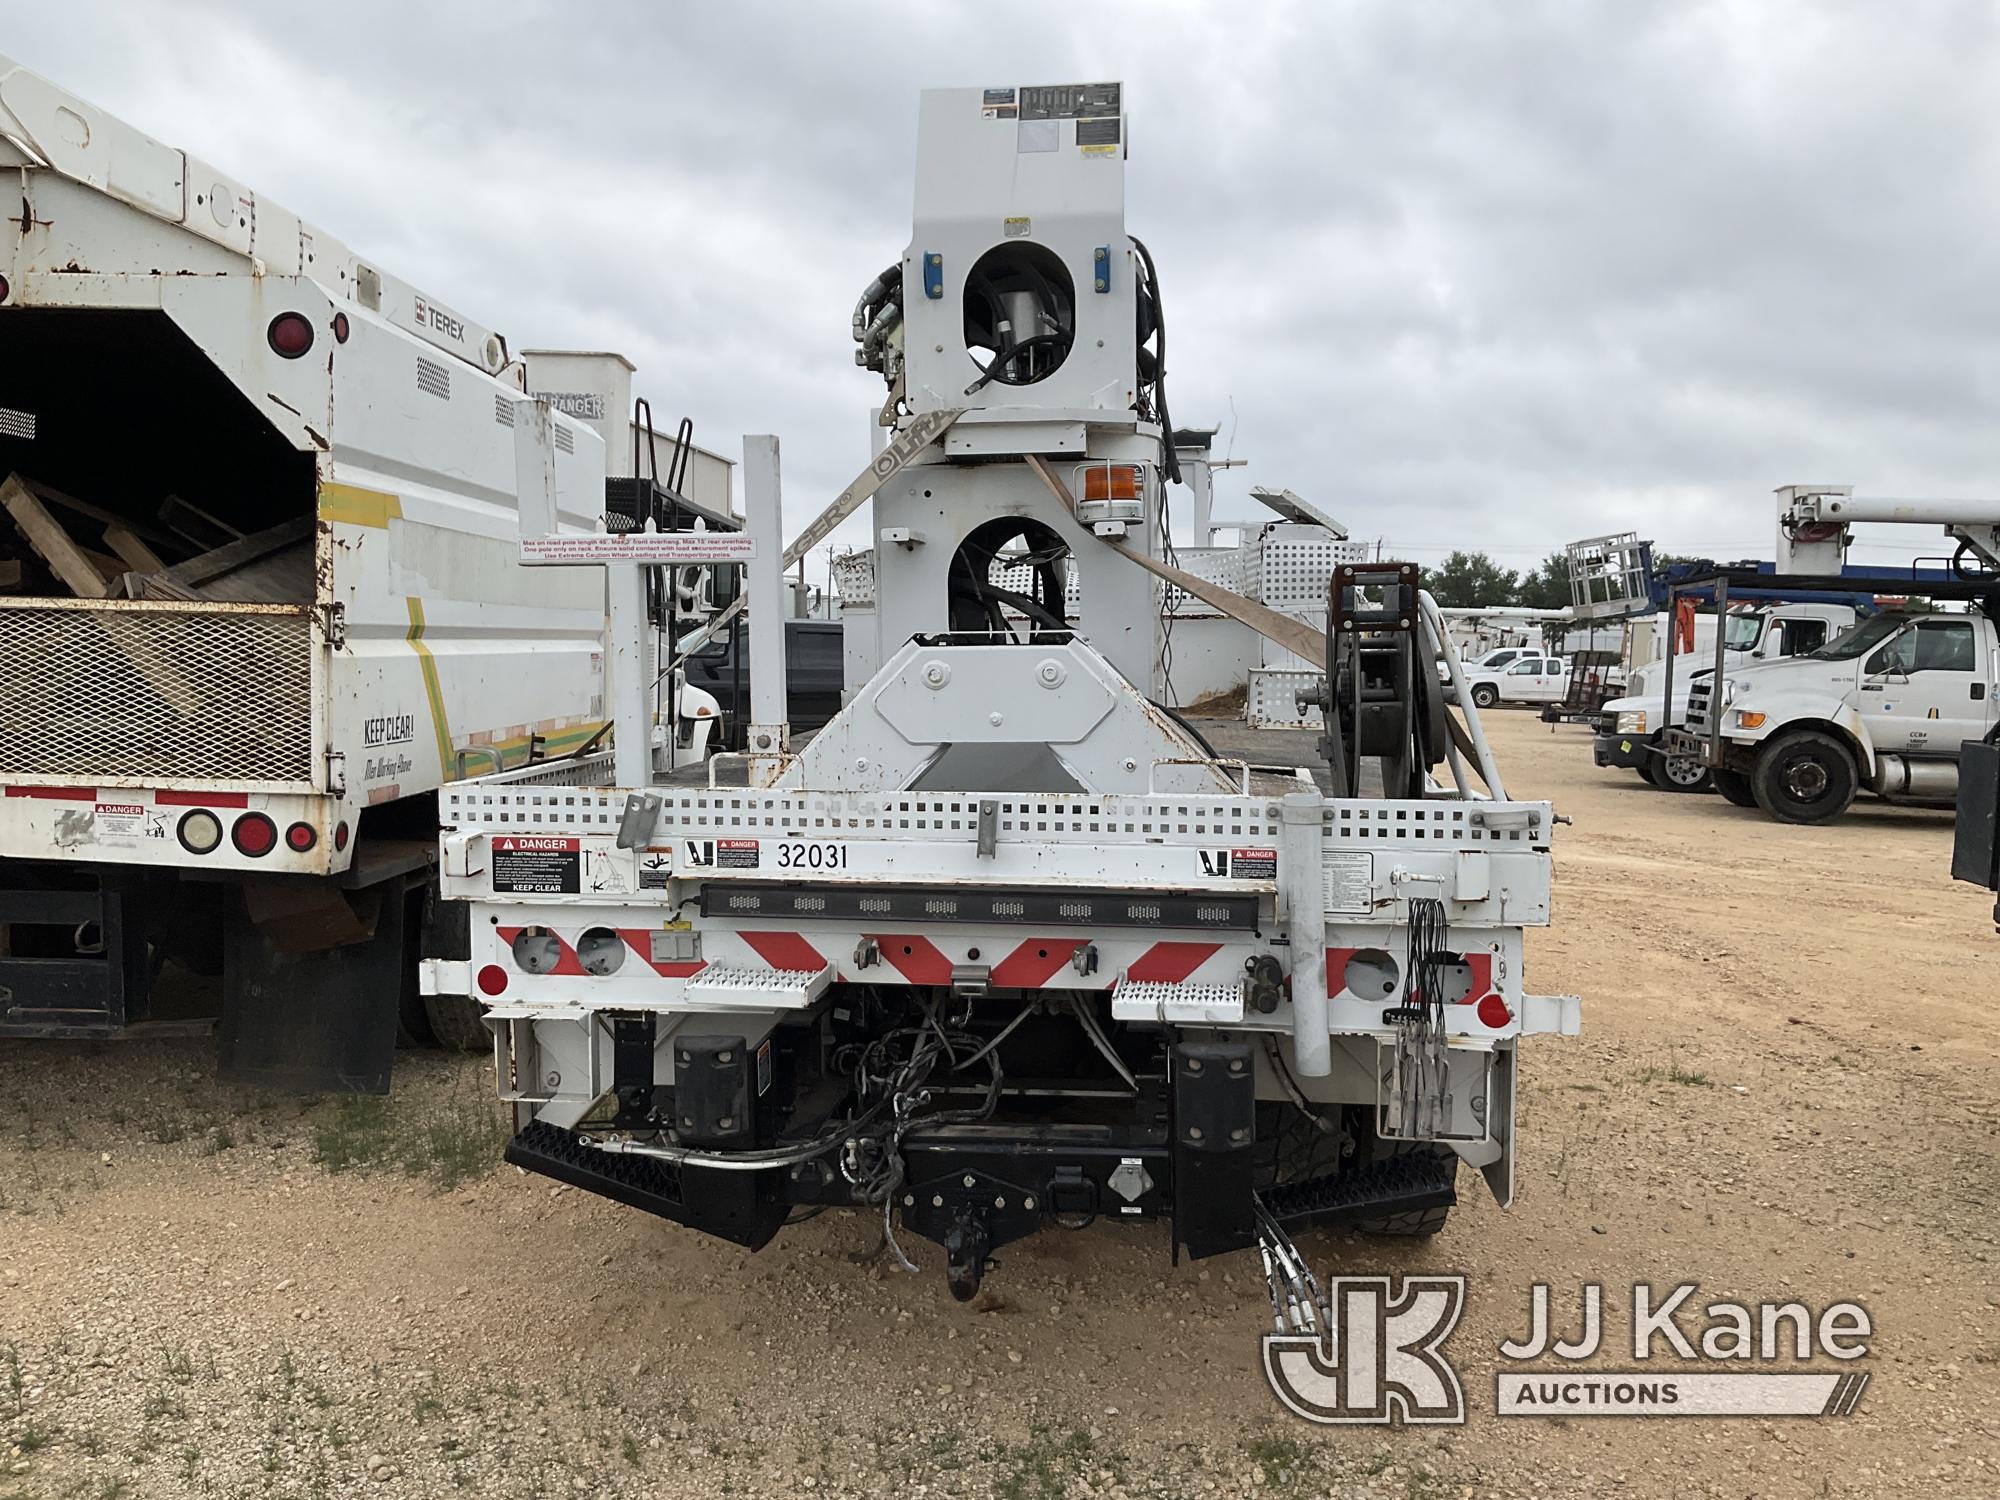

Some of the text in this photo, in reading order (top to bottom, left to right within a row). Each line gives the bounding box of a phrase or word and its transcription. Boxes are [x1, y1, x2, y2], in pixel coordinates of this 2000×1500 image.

[428, 306, 464, 343] TEREX
[364, 714, 414, 745] KEEP CLEAR!
[364, 752, 412, 781] Men Working Above
[105, 804, 142, 815] DANGER
[519, 839, 568, 850] DANGER
[730, 841, 756, 849] DANGER
[777, 843, 847, 869] 32031
[1246, 850, 1274, 859] DANGER
[512, 884, 561, 893] KEEP CLEAR
